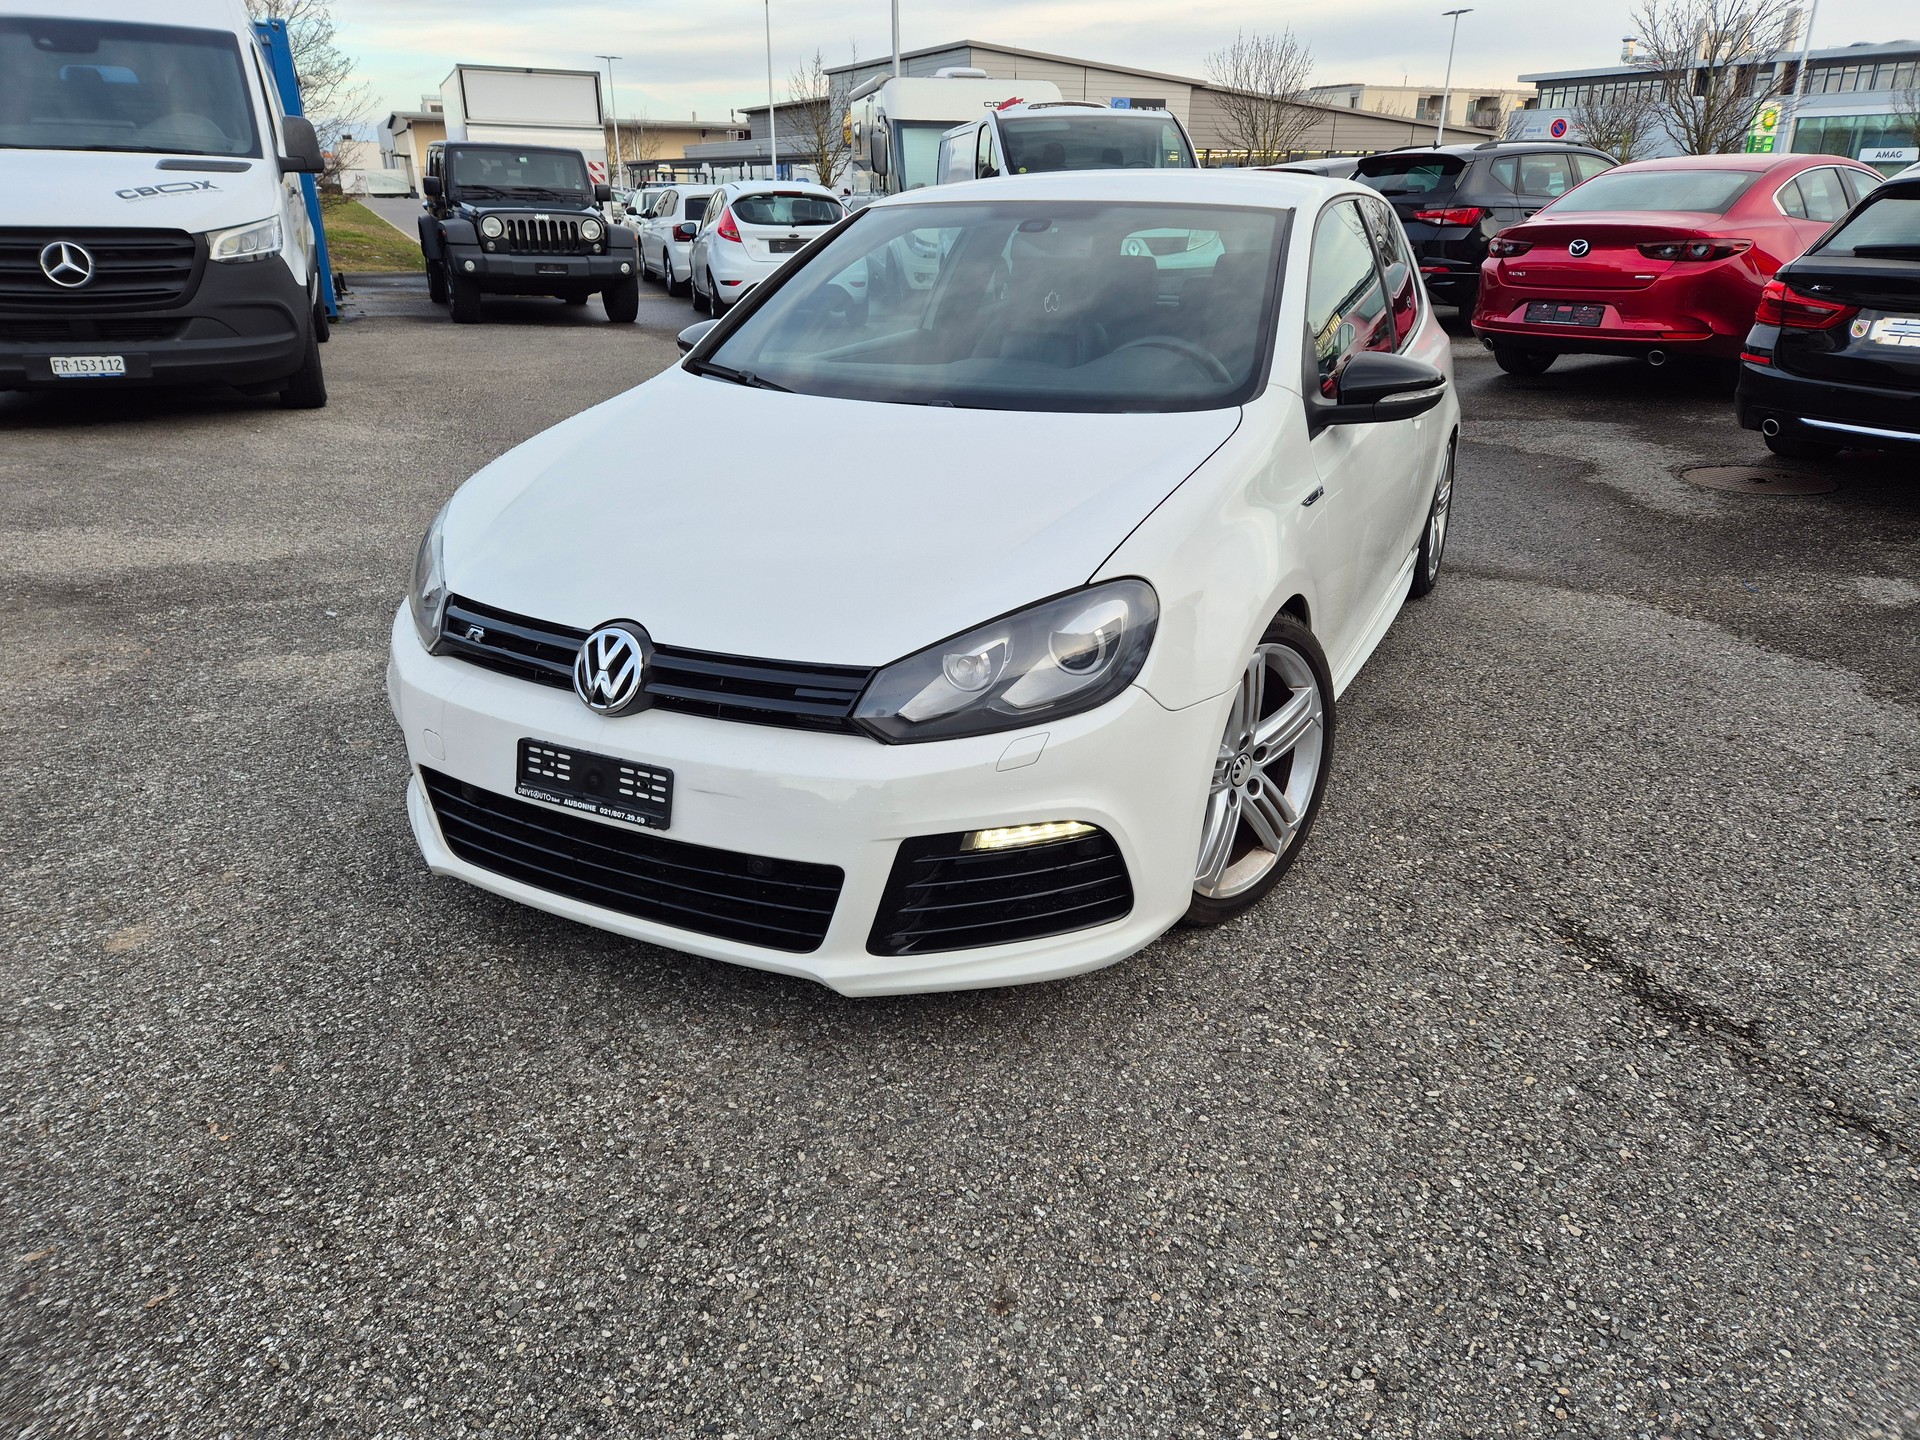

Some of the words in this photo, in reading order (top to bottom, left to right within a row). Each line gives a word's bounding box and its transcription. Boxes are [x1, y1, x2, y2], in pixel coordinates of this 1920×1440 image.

[1875, 150, 1903, 159] AMAG
[114, 180, 219, 200] CBOX
[98, 359, 123, 371] 112
[465, 624, 485, 644] R
[563, 798, 597, 812] AUBONNE
[599, 807, 646, 824] 021/807.29.59
